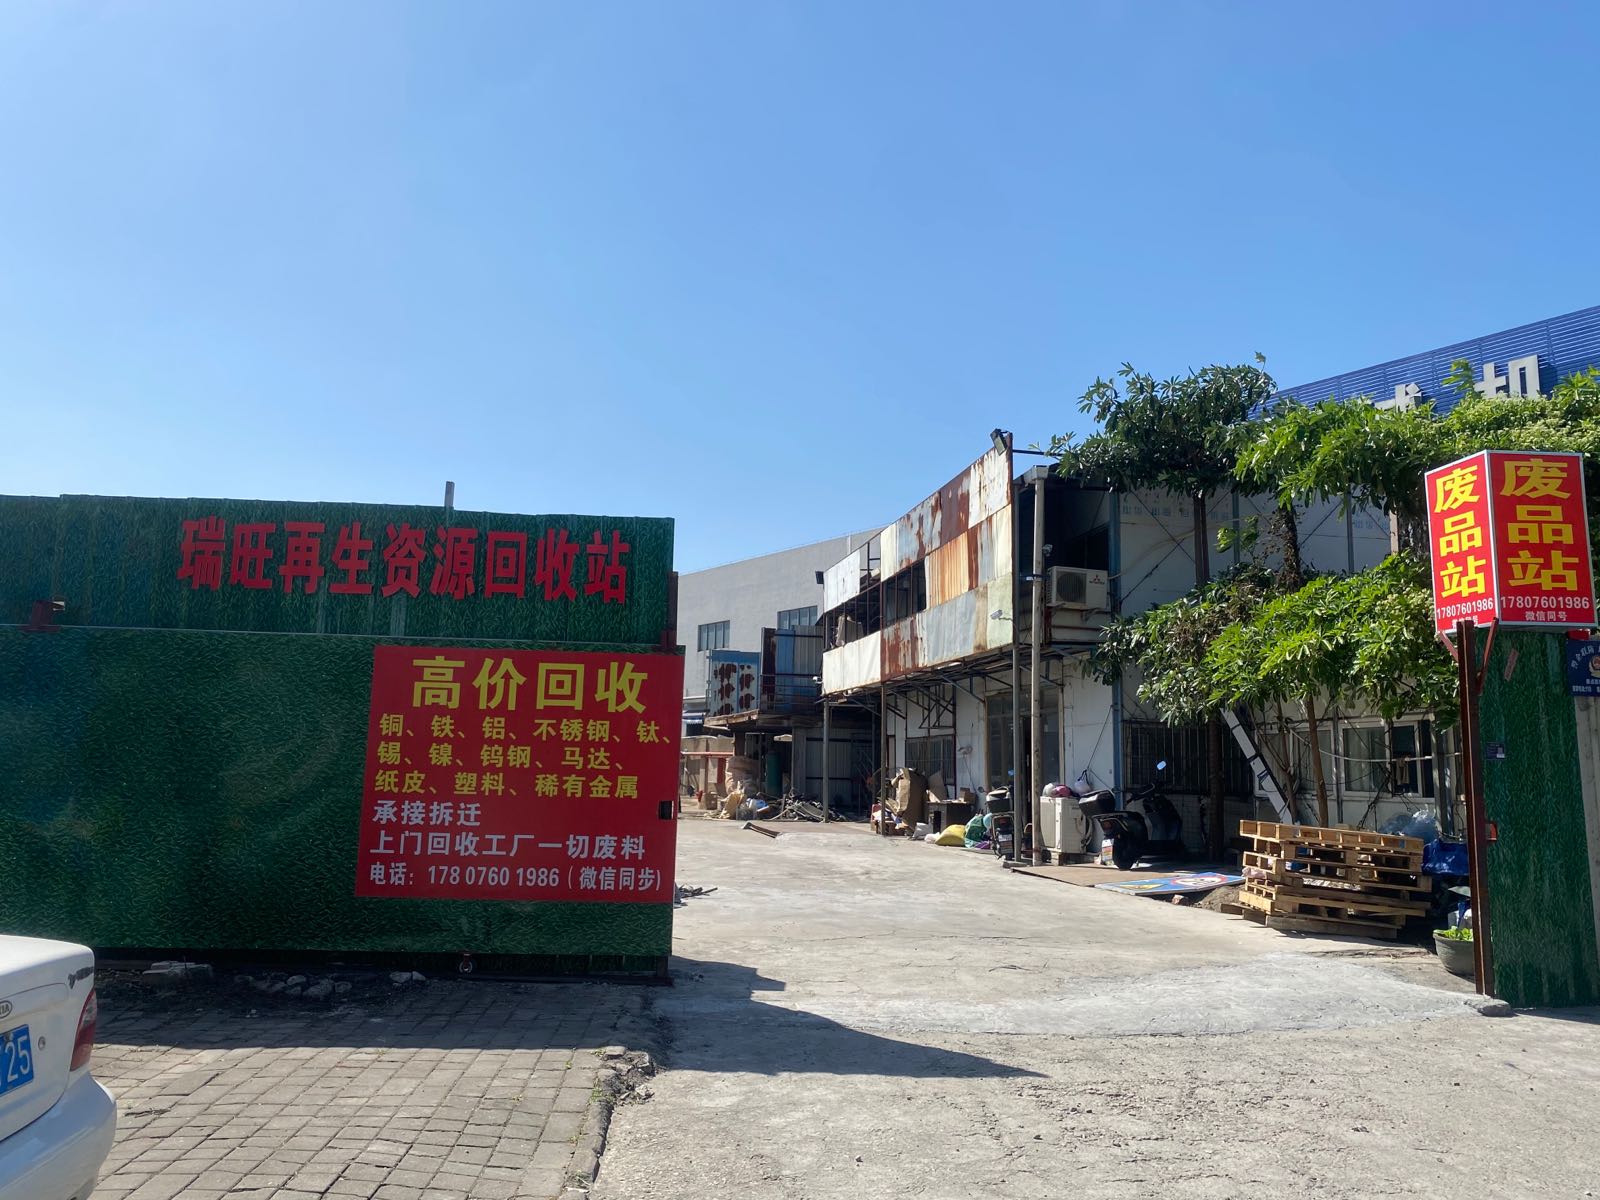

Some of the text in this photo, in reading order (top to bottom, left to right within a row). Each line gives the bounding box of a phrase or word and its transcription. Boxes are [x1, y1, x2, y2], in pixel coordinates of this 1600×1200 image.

[1434, 464, 1487, 598] 废品站
[1500, 458, 1580, 591] 废品站
[177, 515, 630, 604] 瑞旺再生资源回收站
[1437, 598, 1494, 619] 17807601986
[1501, 596, 1590, 609] 17807601986
[1525, 611, 1567, 622] 微信同号
[412, 655, 649, 713] 高价回收
[372, 800, 482, 826] 承接拆迁
[370, 830, 646, 860] 上门回收工厂一切废料
[428, 866, 460, 885] 178
[465, 866, 510, 886] 0760
[516, 867, 560, 887] 1986
[0, 1035, 30, 1083] 25
